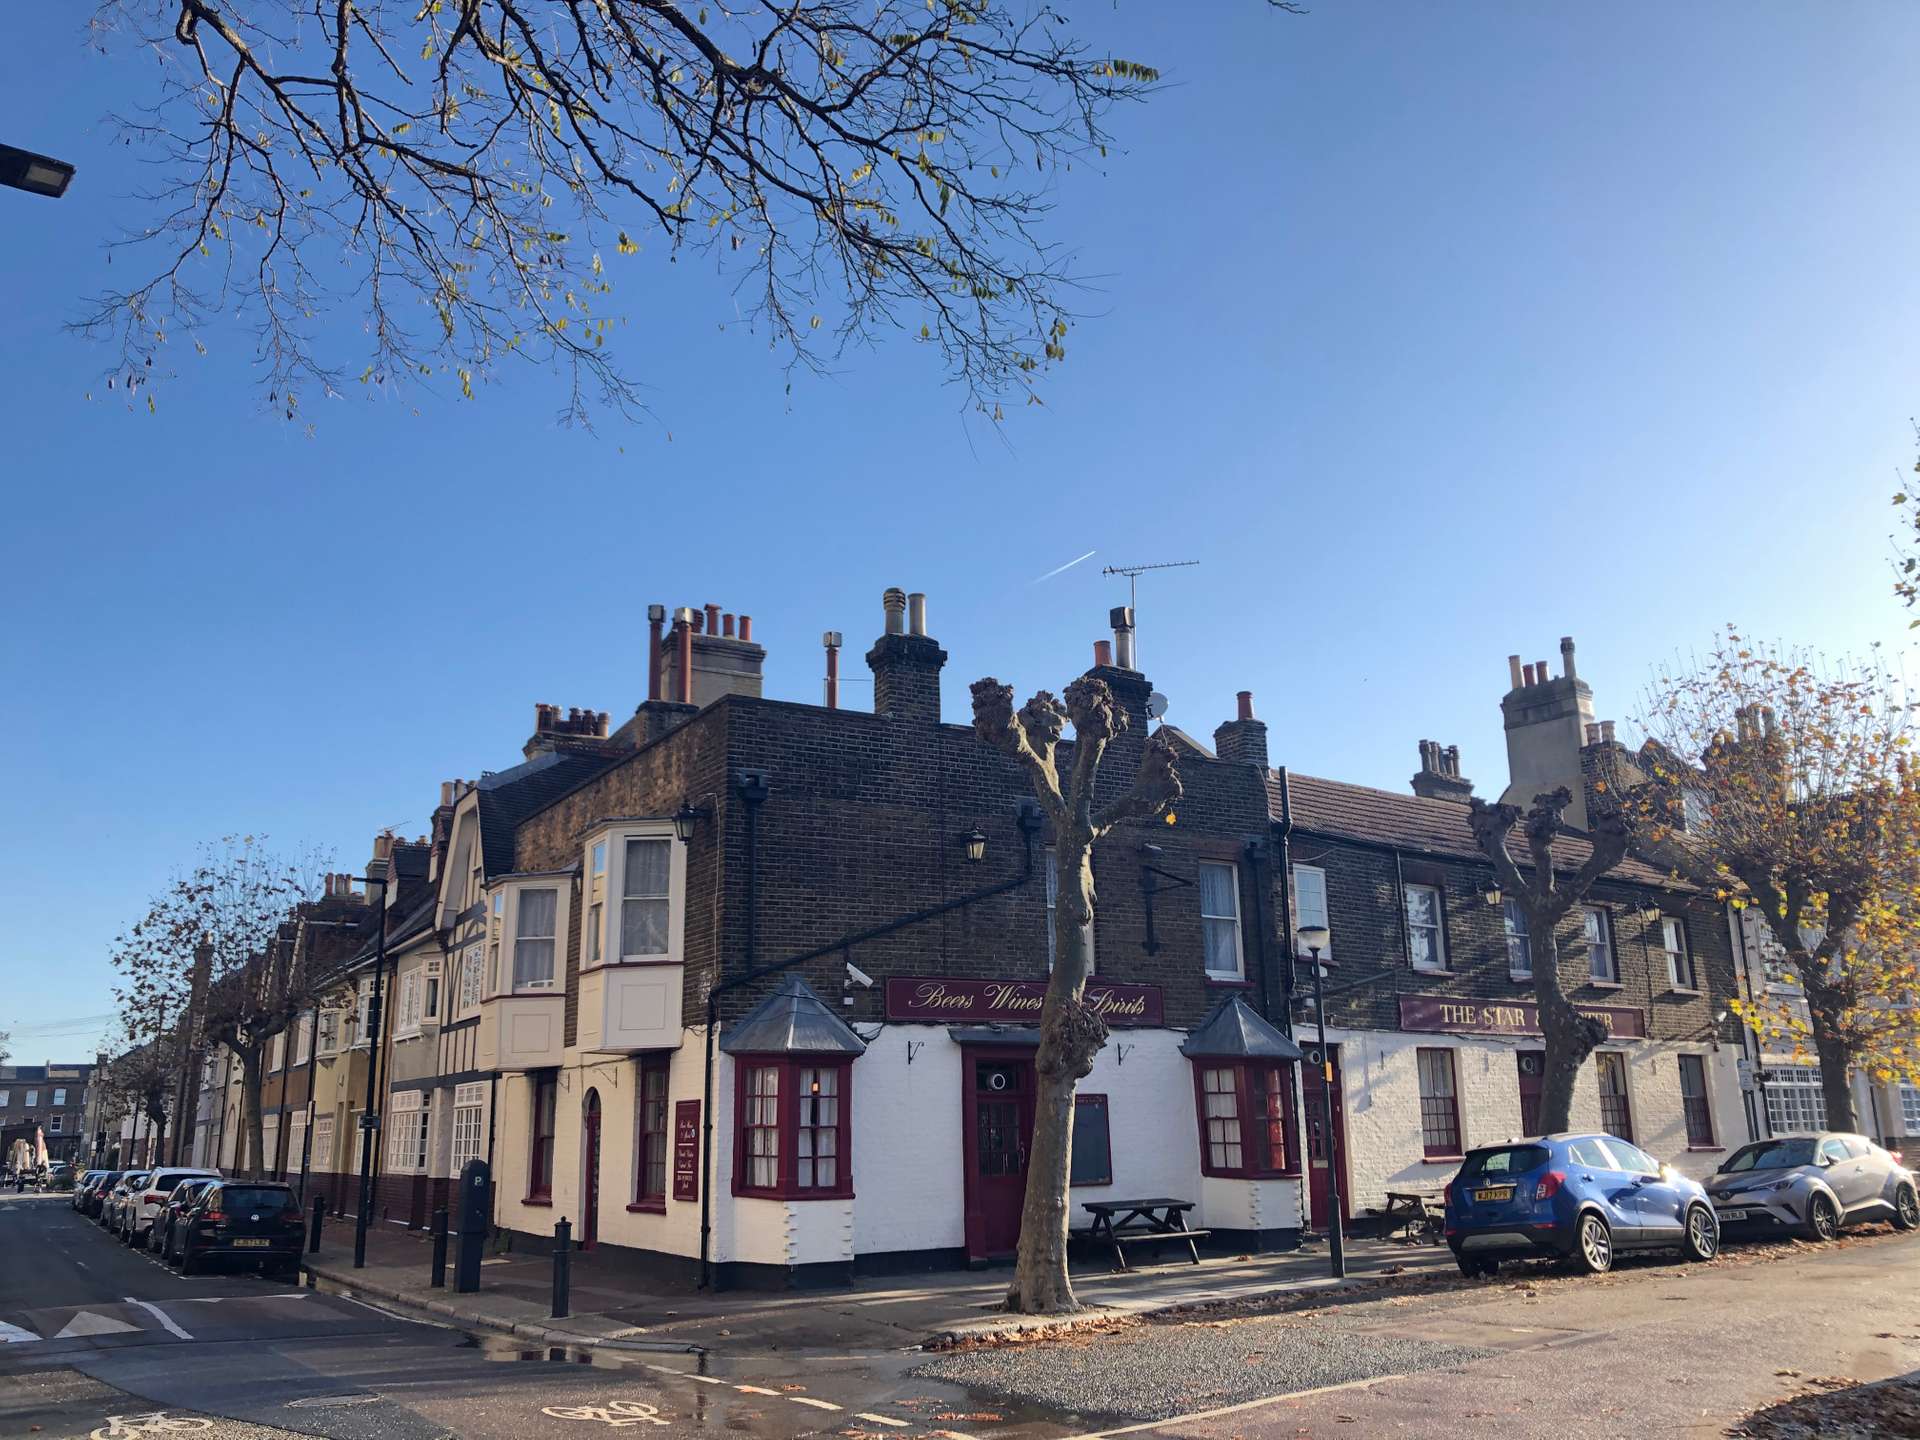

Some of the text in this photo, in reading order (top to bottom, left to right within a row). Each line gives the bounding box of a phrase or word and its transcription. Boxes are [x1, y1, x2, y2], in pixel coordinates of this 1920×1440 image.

[908, 983, 1145, 1015] Beers Wines Spirits
[1440, 1004, 1476, 1025] THE
[1482, 1006, 1525, 1026] STAR
